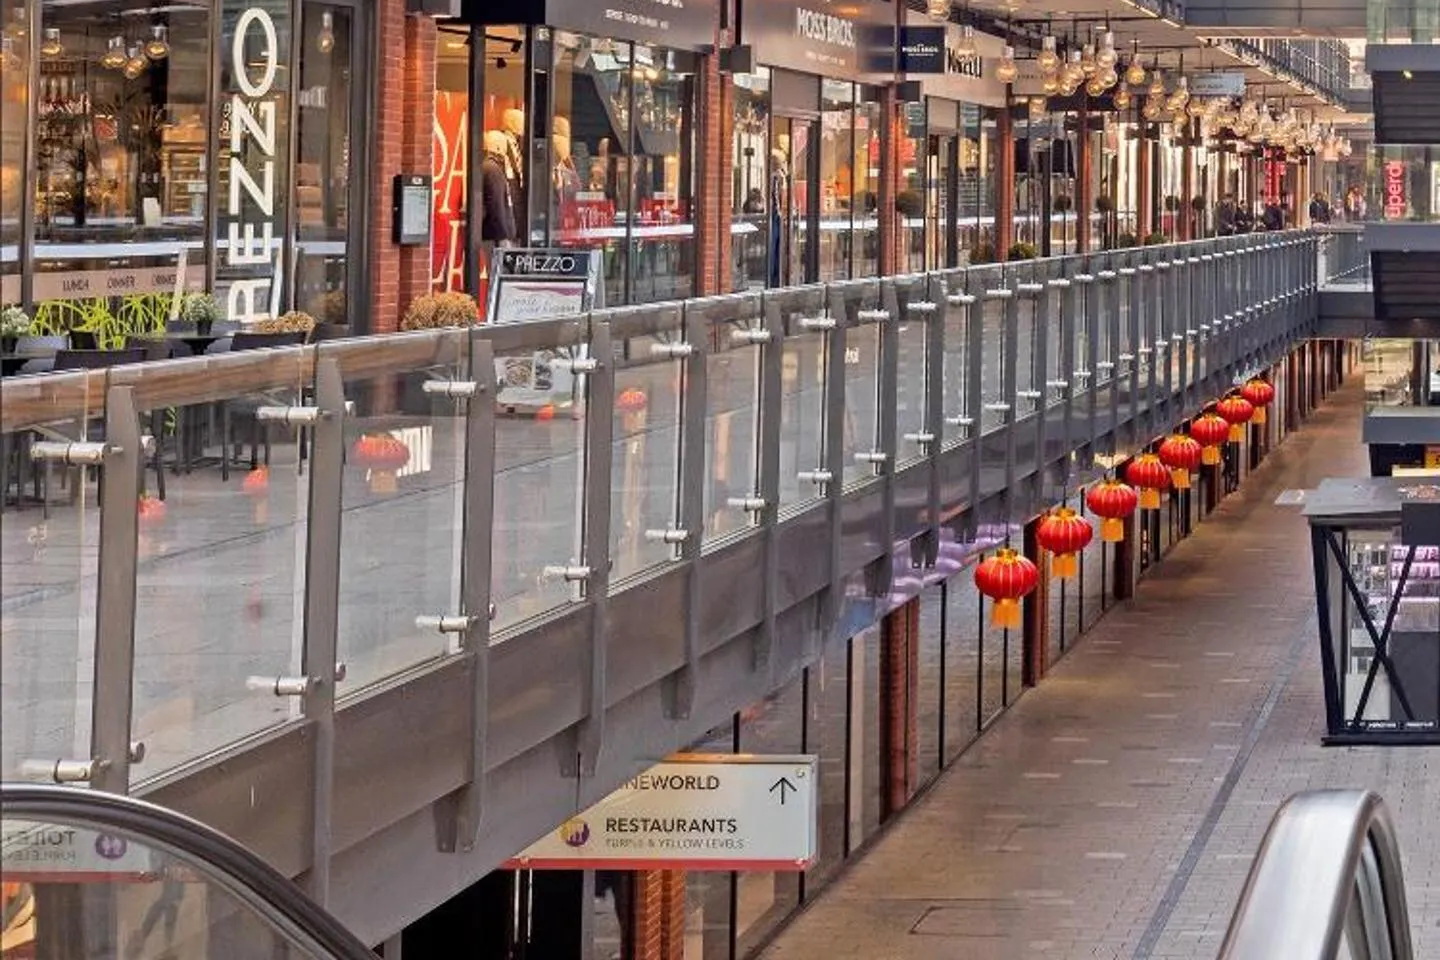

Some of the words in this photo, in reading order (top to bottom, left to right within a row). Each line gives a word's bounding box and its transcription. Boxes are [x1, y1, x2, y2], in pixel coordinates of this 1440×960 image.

[796, 7, 827, 41] MOSS
[227, 7, 278, 321] REZZO
[514, 254, 576, 273] PREZZO
[624, 775, 720, 790] NEWORLD
[605, 818, 738, 834] RESTAURANTS
[658, 839, 702, 849] YELLOW
[706, 839, 745, 849] LEVELS
